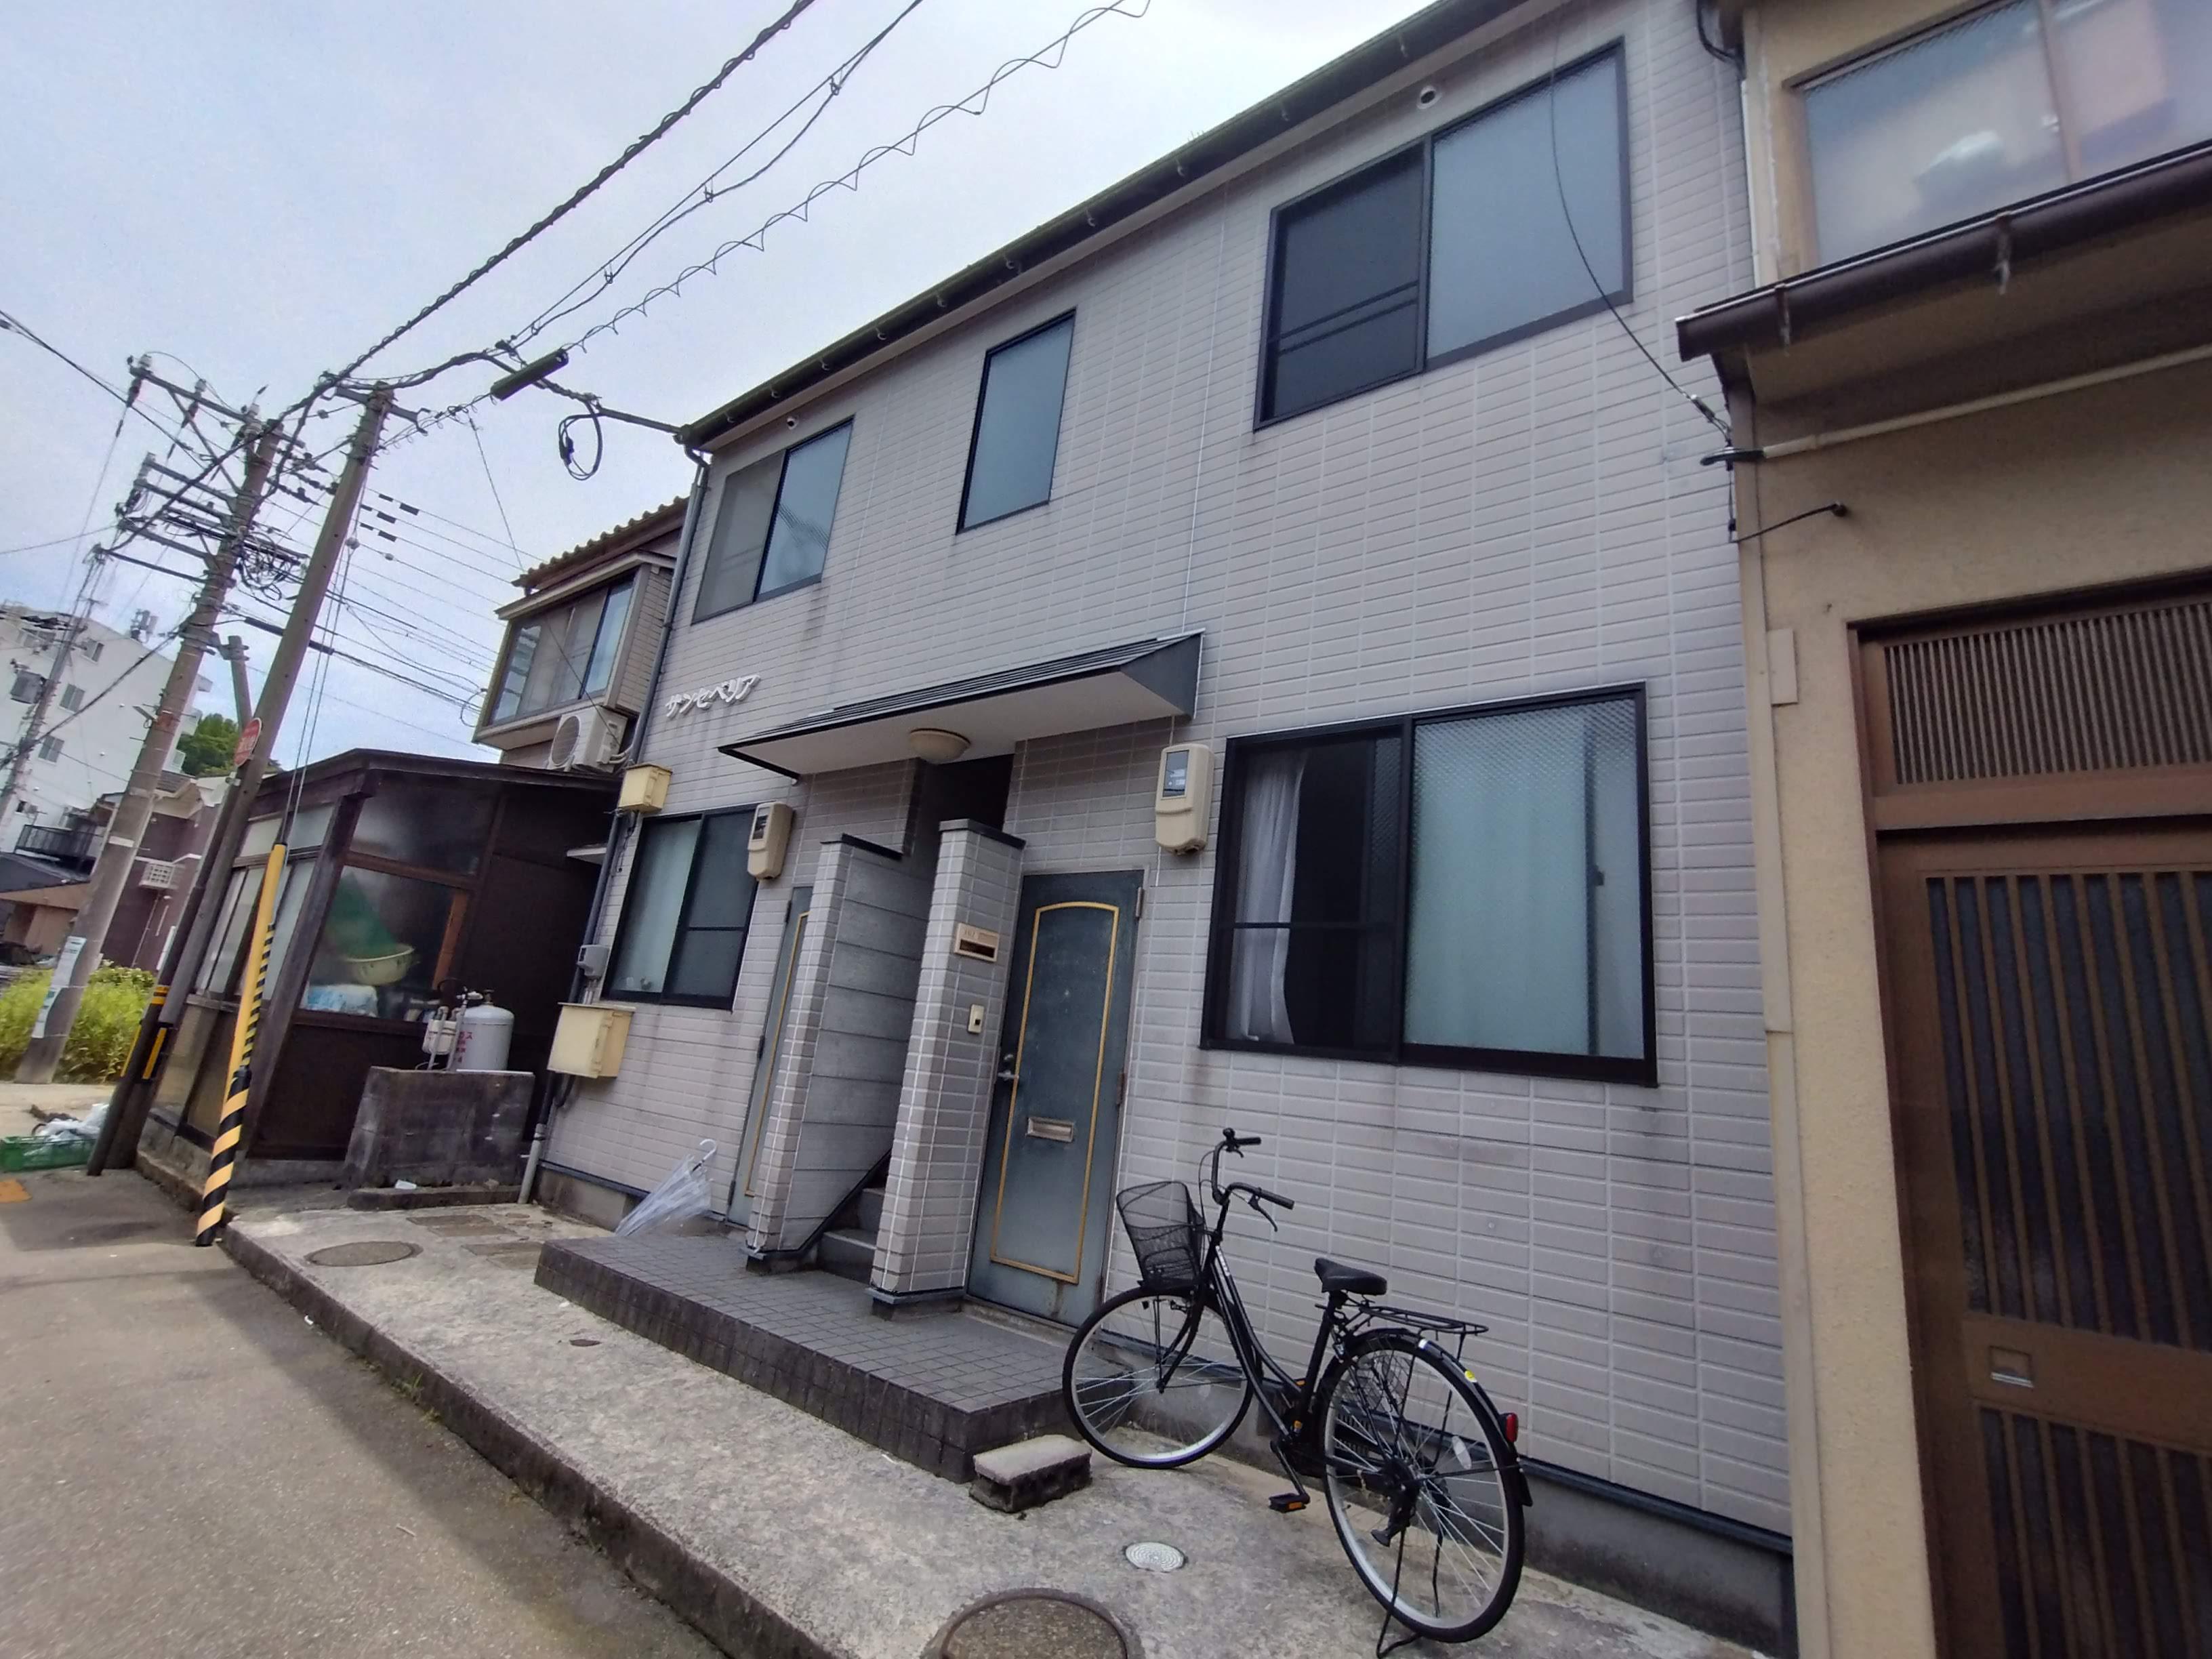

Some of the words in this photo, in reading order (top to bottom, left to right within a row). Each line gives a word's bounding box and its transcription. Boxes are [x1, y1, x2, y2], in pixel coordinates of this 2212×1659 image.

[665, 674, 760, 718] サンセベリア
